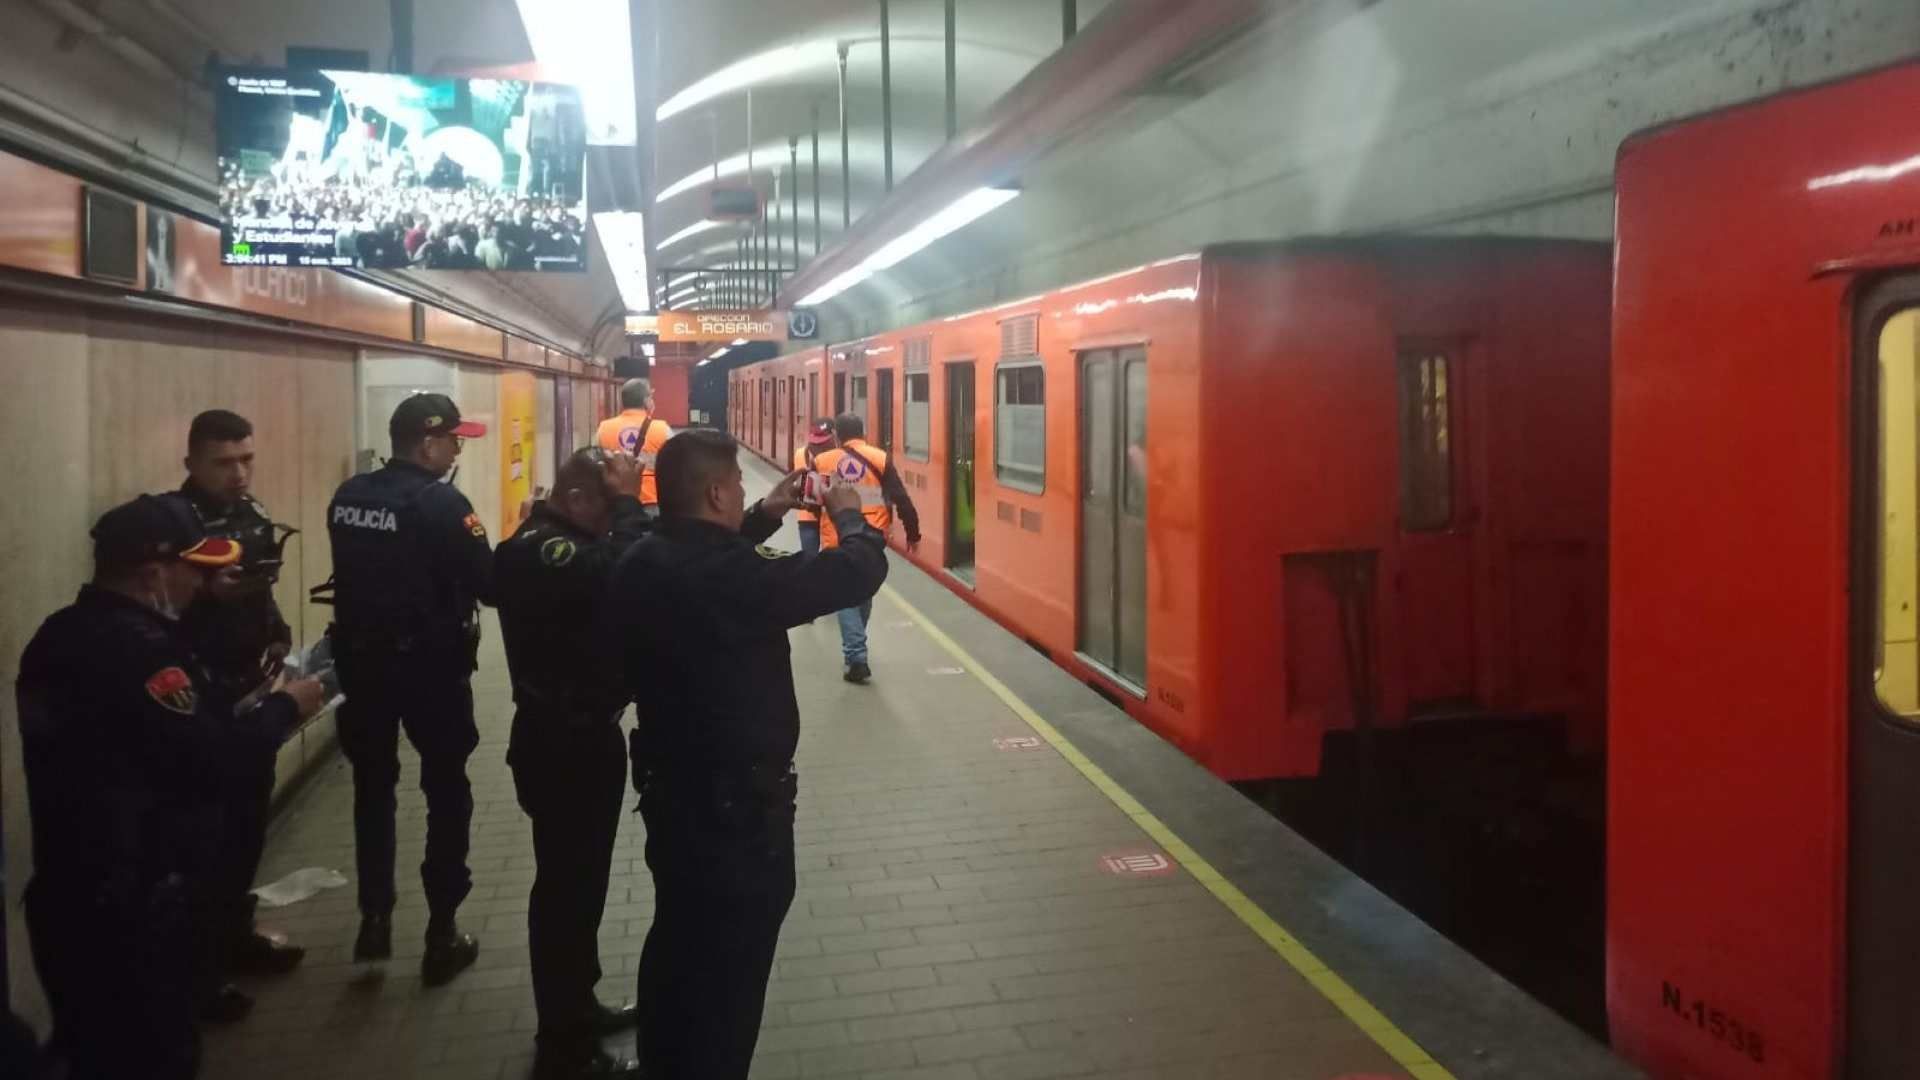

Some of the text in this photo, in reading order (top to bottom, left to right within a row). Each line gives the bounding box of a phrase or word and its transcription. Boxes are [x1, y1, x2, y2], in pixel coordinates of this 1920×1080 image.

[673, 321, 774, 335] EL ROSARIO
[332, 505, 397, 532] POLICÍA
[1662, 979, 1765, 1064] N.1538
